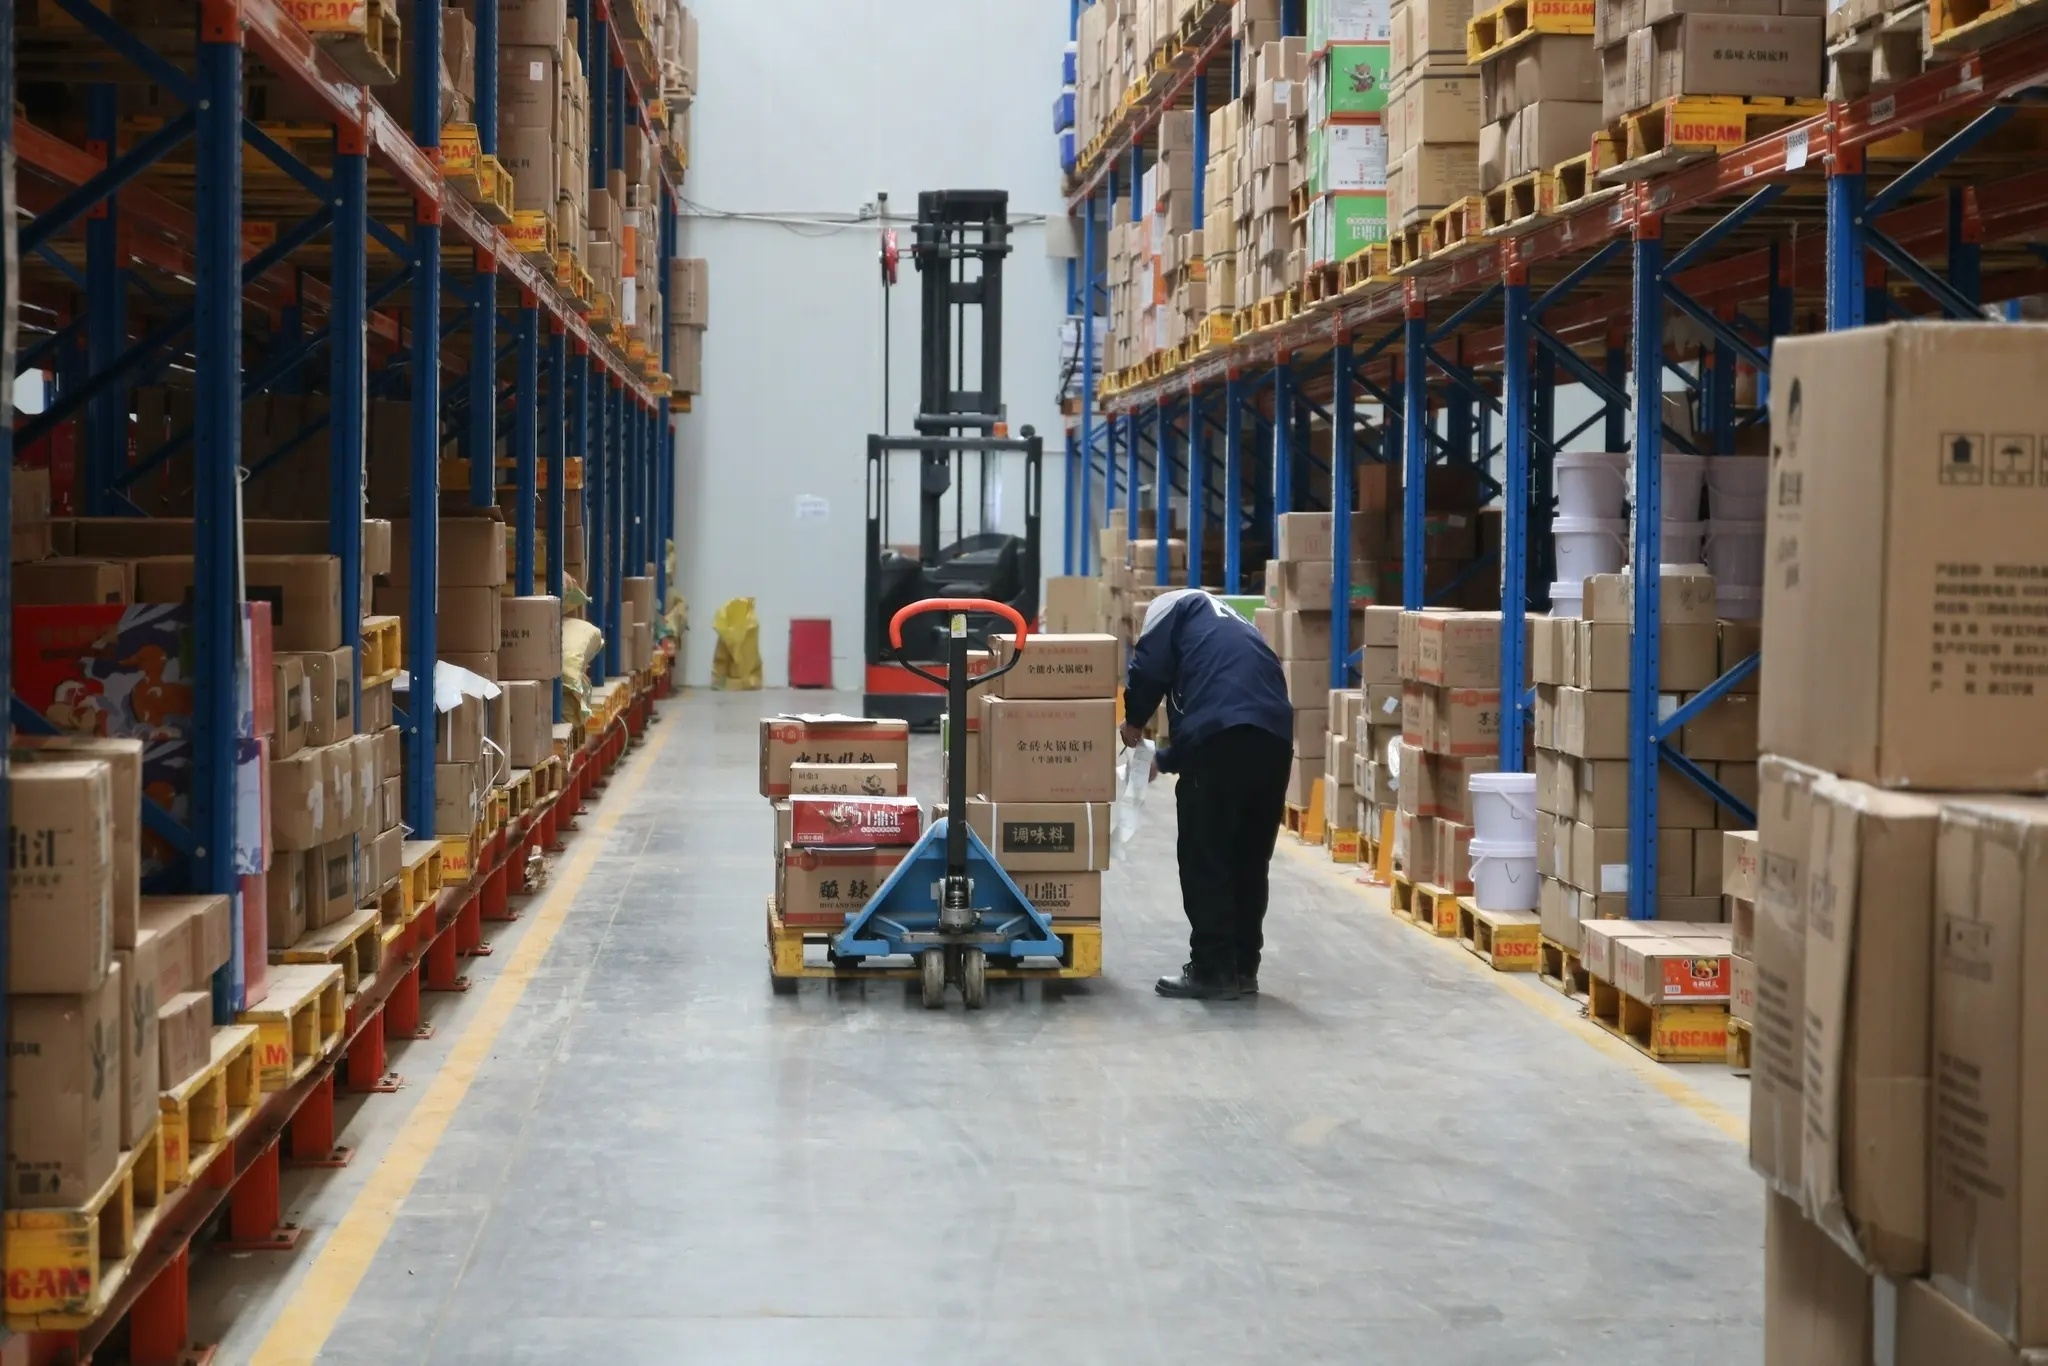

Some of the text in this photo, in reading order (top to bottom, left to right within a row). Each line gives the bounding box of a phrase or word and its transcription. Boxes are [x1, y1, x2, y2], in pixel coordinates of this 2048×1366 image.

[1533, 2, 1593, 15] LOSCAM
[1713, 49, 1788, 63] 番茄味火锅底料
[1675, 123, 1742, 141] LOSCAM
[1027, 664, 1093, 674] 全能小火锅底料
[1016, 740, 1093, 751] 金砖火锅底料
[1012, 825, 1065, 844] 调味料
[819, 879, 884, 900] 酸辣
[1660, 1031, 1726, 1047] LOSCAM
